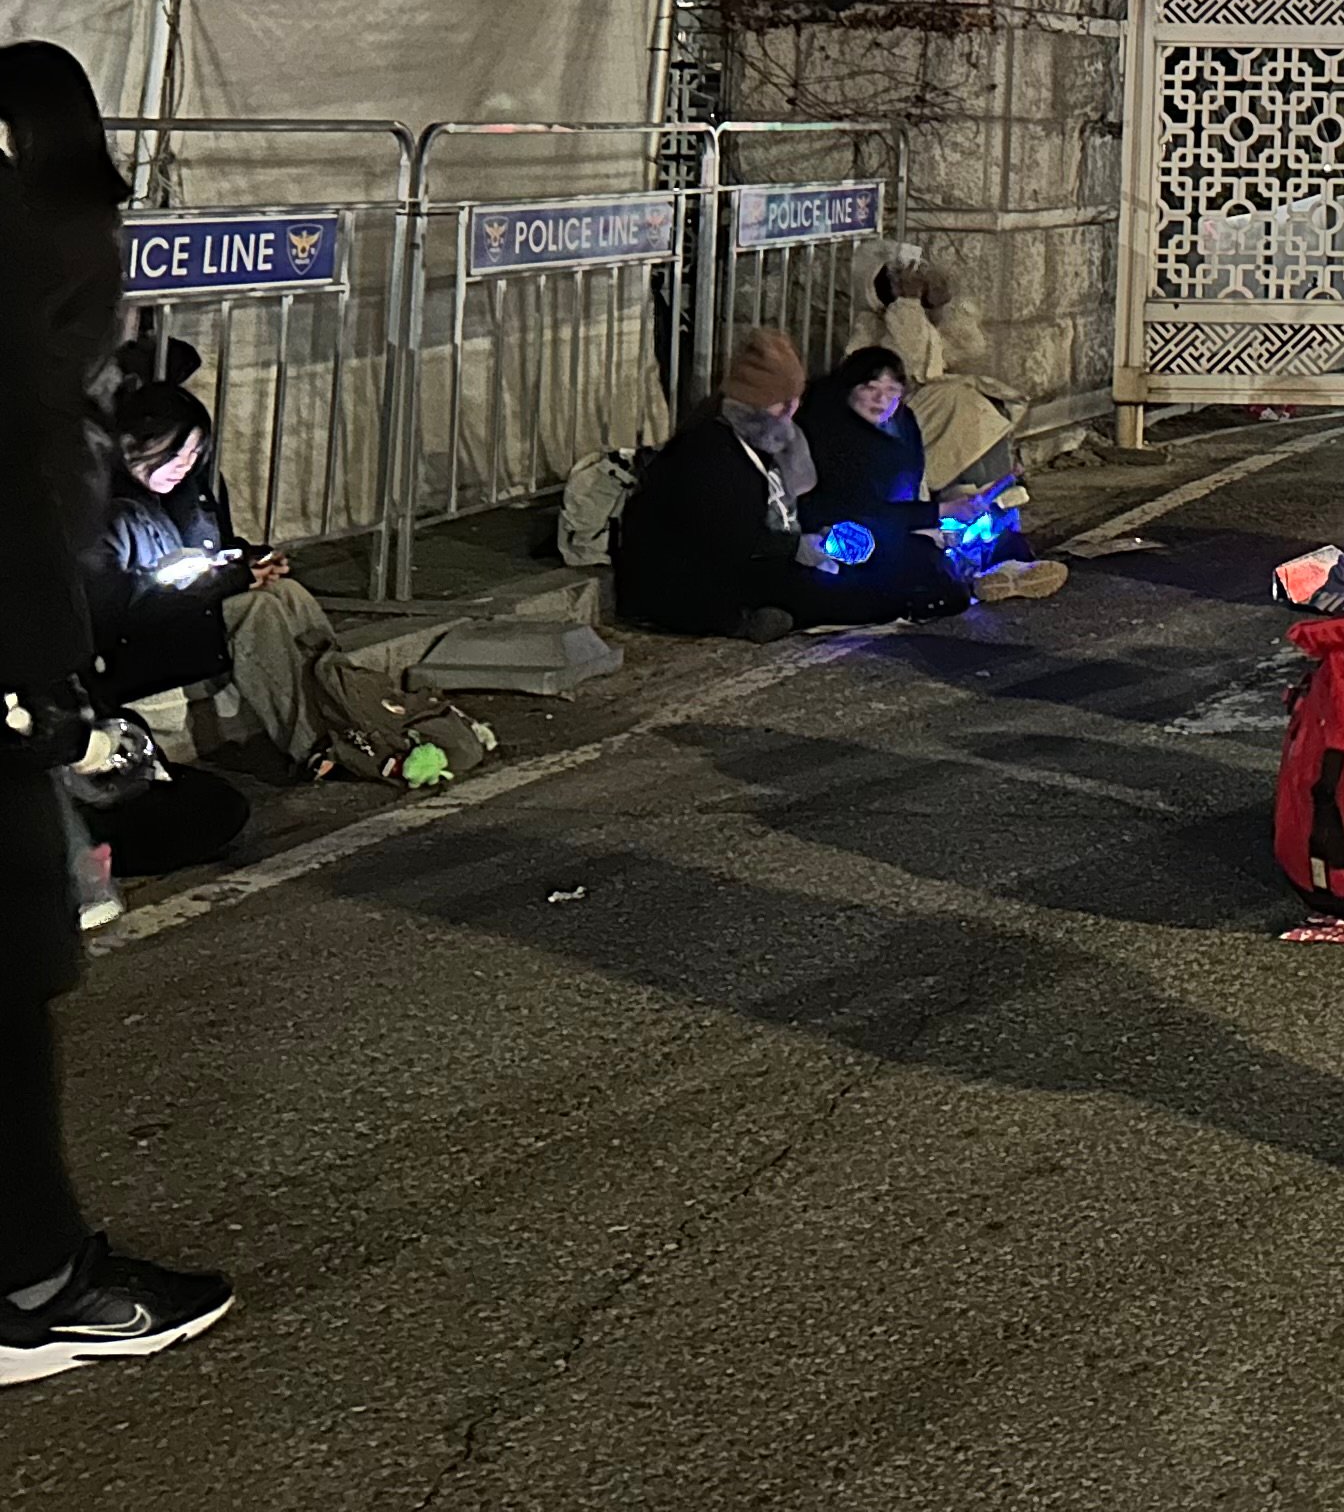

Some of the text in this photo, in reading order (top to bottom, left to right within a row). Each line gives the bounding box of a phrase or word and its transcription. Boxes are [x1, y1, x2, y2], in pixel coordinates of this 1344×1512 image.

[514, 214, 639, 254] POLICE LINE
[768, 197, 853, 231] POLICE LINE
[129, 232, 275, 279] ICE LINE
